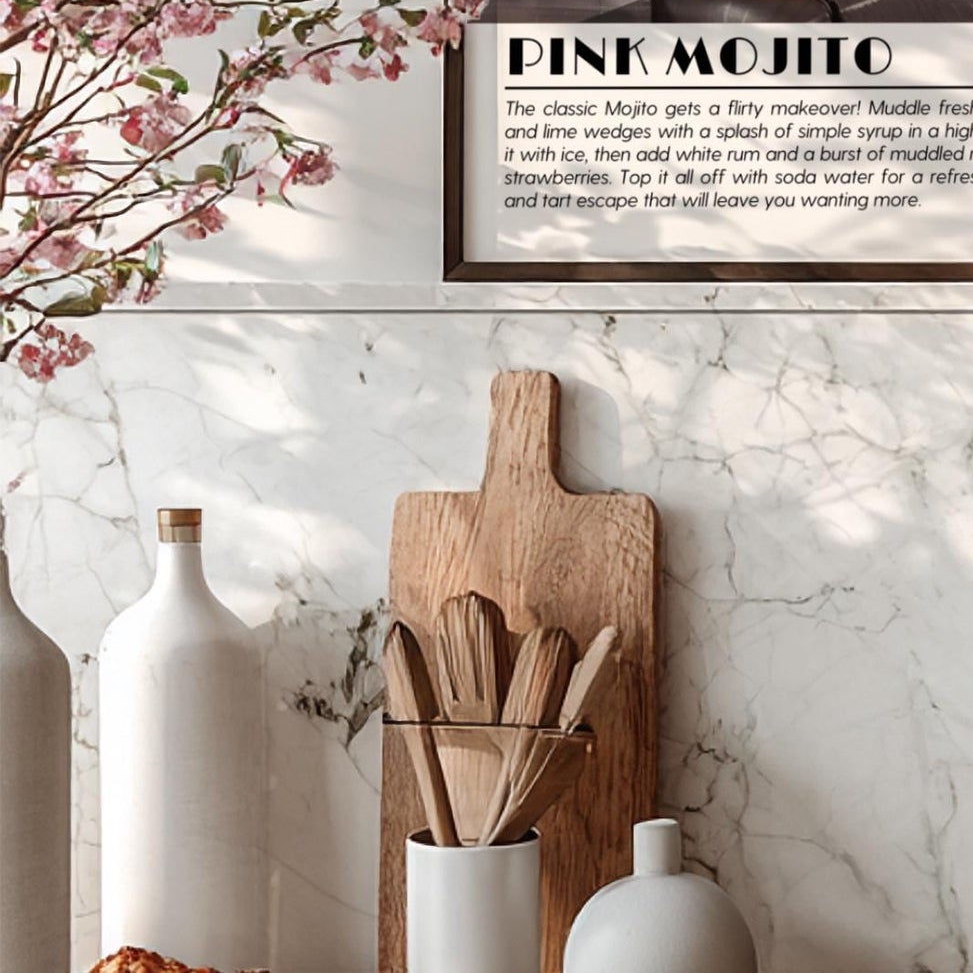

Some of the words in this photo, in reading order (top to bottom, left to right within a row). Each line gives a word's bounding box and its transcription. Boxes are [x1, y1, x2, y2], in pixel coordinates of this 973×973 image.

[509, 36, 648, 76] PINK
[665, 36, 892, 75] MOJITO
[507, 100, 535, 116] The
[543, 100, 597, 116] classic
[605, 100, 658, 119] Mojito
[665, 102, 701, 120] gets
[709, 104, 720, 116] a
[728, 100, 764, 119] flirty
[771, 100, 861, 115] makeover!
[869, 100, 931, 115] Muddle
[505, 123, 538, 139] and
[543, 123, 577, 139] lime
[584, 123, 651, 142] wedges
[658, 123, 693, 138] with
[699, 127, 711, 139] a
[716, 123, 768, 142] splash
[774, 123, 794, 138] of
[798, 123, 851, 141] simple
[858, 127, 902, 141] syrup
[908, 123, 922, 138] in
[928, 127, 939, 138] a
[505, 147, 514, 161] it
[520, 146, 556, 162] with
[561, 147, 588, 164] ice,
[595, 146, 631, 162] then
[636, 146, 671, 162] add
[676, 146, 722, 162] white
[727, 150, 760, 161] rum
[766, 145, 799, 161] and
[803, 149, 815, 161] a
[820, 146, 862, 161] burst
[867, 145, 886, 161] of
[890, 145, 964, 161] muddled
[504, 169, 612, 185] strawberries.
[621, 169, 651, 188] Top
[658, 169, 668, 184] it
[675, 169, 694, 184] all
[700, 168, 727, 185] off
[732, 169, 768, 184] with
[775, 169, 816, 184] soda
[824, 170, 874, 184] water
[882, 168, 905, 184] for
[912, 173, 923, 184] a
[504, 192, 538, 208] and
[543, 194, 571, 208] tart
[576, 196, 638, 211] escape
[645, 192, 676, 207] that
[682, 192, 708, 208] will
[713, 192, 760, 208] leave
[765, 196, 795, 211] you
[801, 192, 869, 211] wanting
[874, 196, 921, 207] more.
